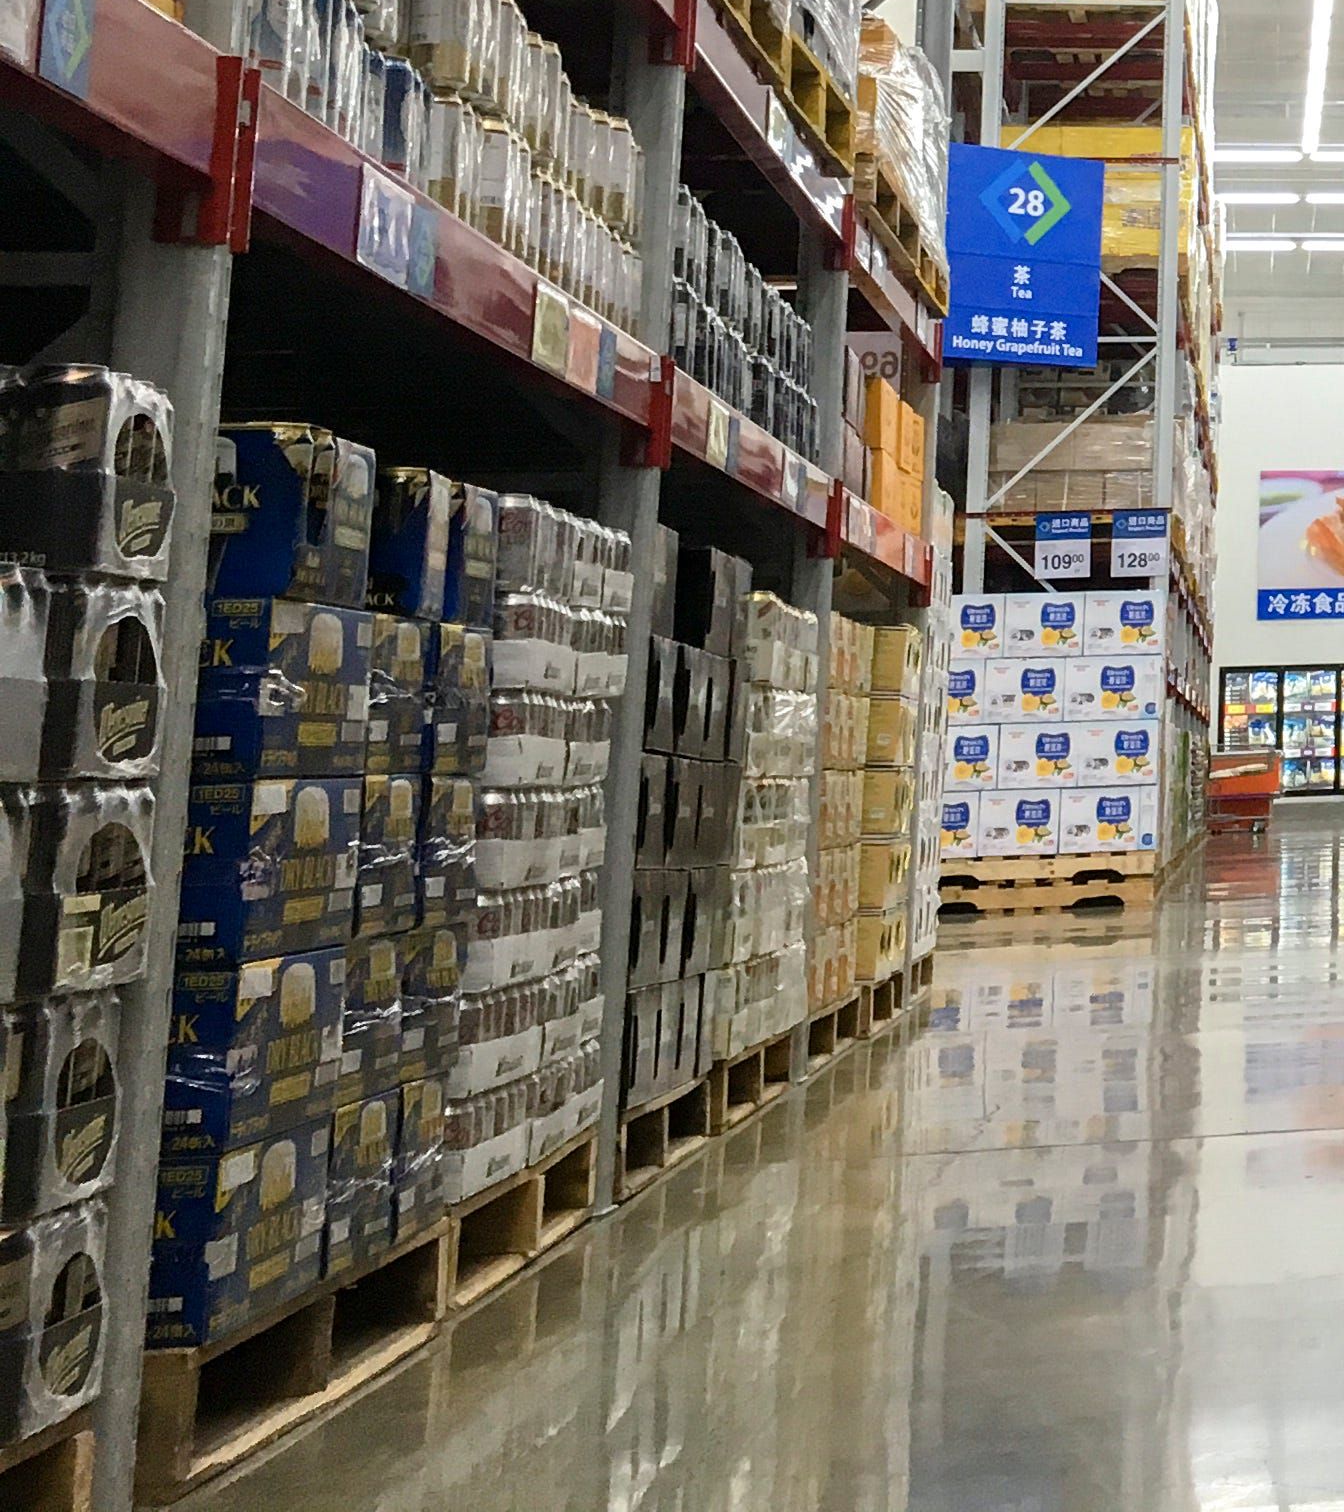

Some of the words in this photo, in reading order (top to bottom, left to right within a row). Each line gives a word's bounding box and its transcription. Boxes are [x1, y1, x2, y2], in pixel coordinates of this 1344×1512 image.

[1007, 187, 1045, 217] 28
[1013, 265, 1031, 285] 茶
[1011, 286, 1033, 299] Tea
[970, 314, 1067, 341] 蜂蜜柚子茶
[952, 335, 994, 353] Honey
[996, 338, 1061, 357] Grapefruit
[1062, 343, 1083, 358] Tea
